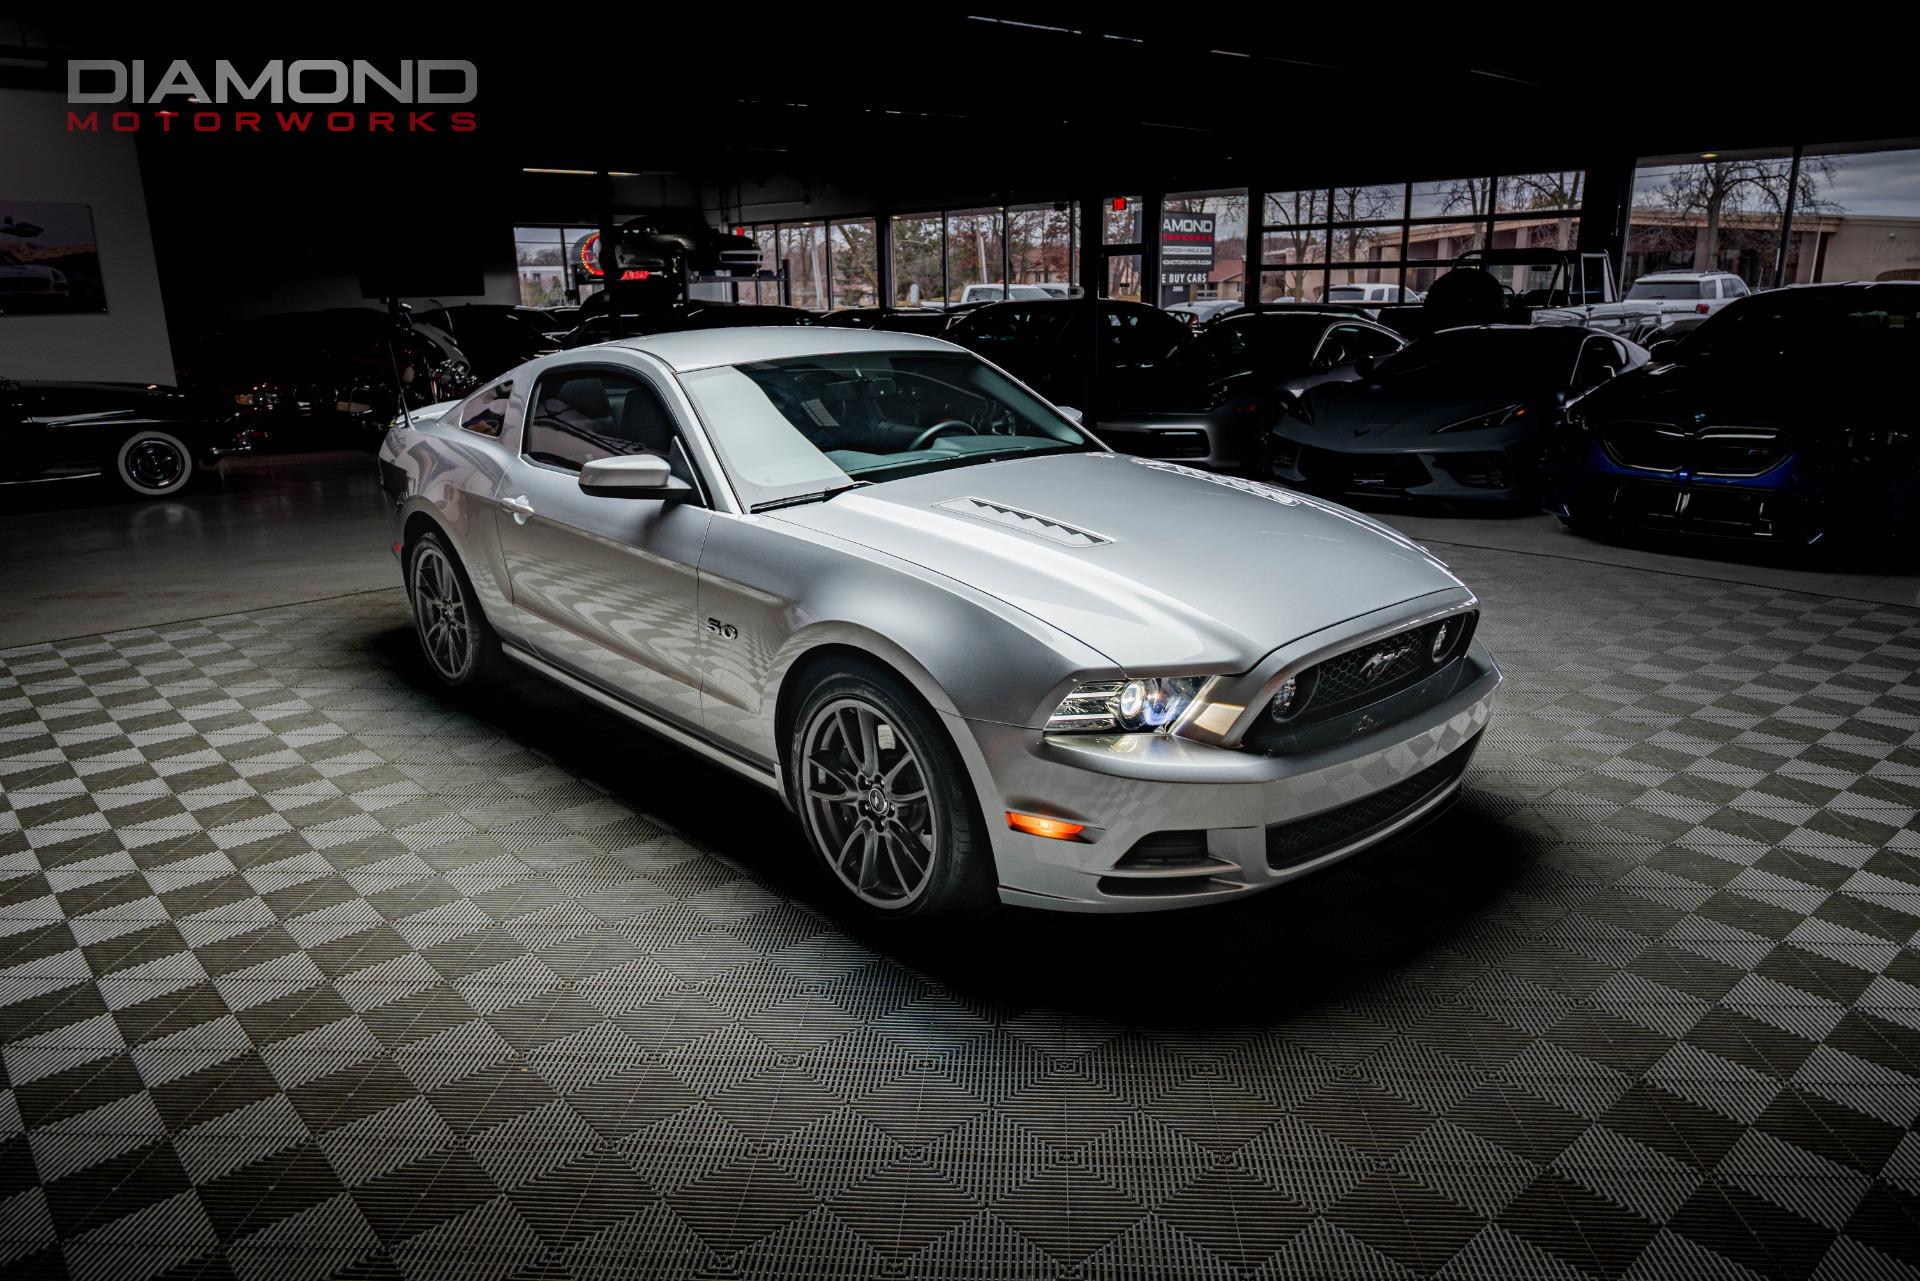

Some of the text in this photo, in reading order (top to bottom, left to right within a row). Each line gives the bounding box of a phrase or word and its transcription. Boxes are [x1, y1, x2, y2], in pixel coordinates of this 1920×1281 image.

[1163, 219, 1213, 232] AMOND
[1161, 273, 1207, 283] E BUY CARS
